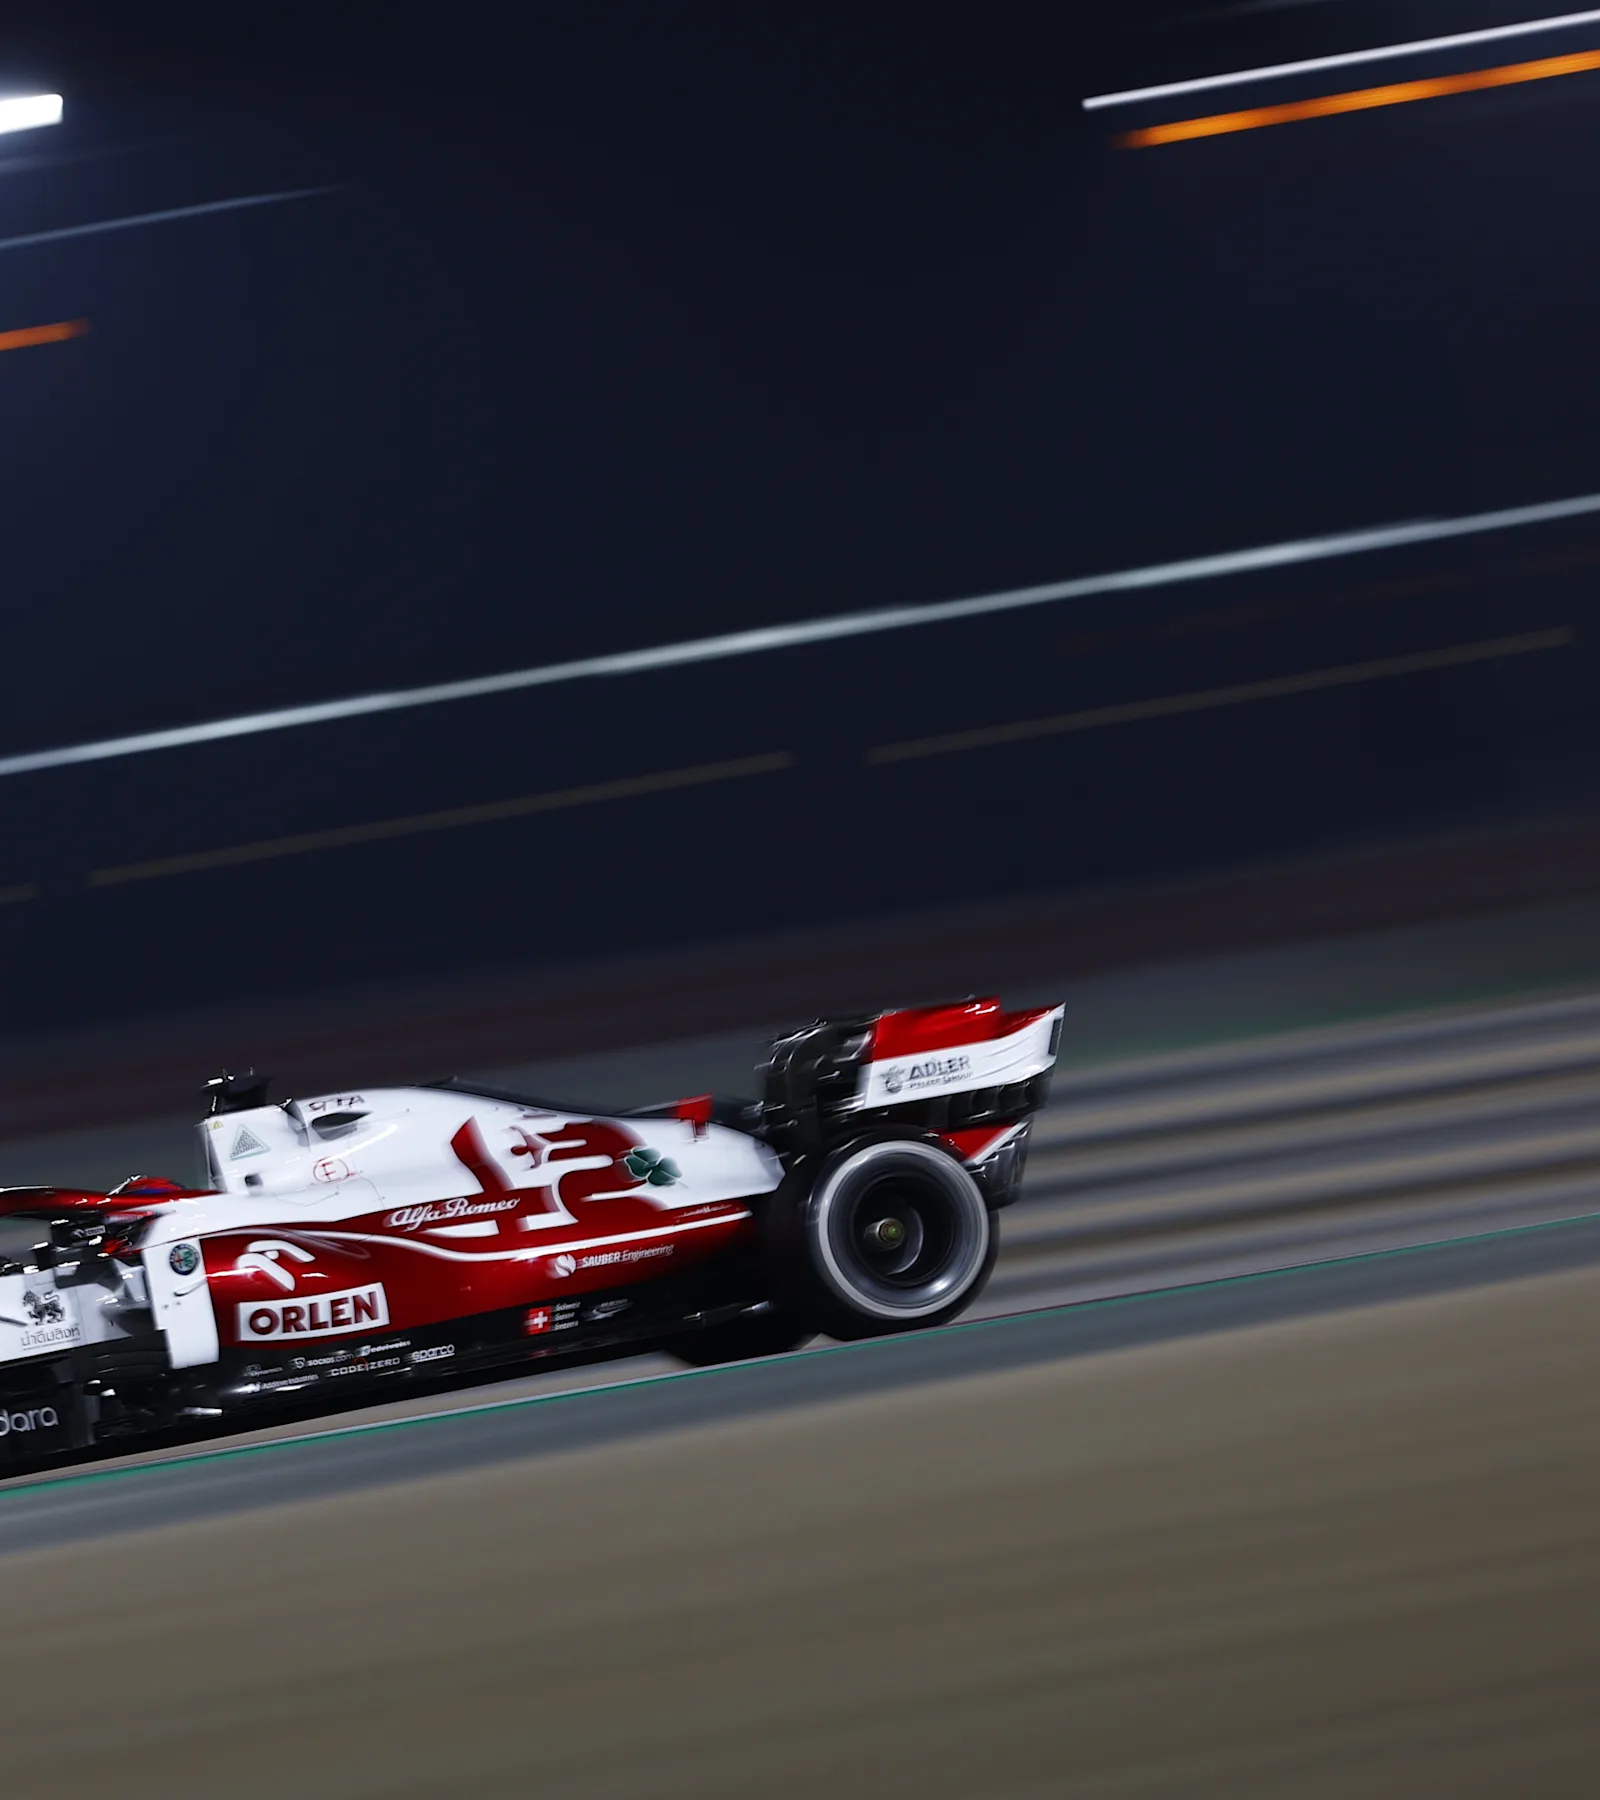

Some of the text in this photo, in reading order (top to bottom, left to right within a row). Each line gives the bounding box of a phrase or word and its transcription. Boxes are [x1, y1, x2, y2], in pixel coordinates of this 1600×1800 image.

[908, 1056, 970, 1080] ADLER
[387, 1197, 520, 1232] Alfa Romeo
[580, 1243, 675, 1268] SAUBER Engineering
[250, 1291, 380, 1335] ORLEN
[411, 1344, 455, 1362] sparco
